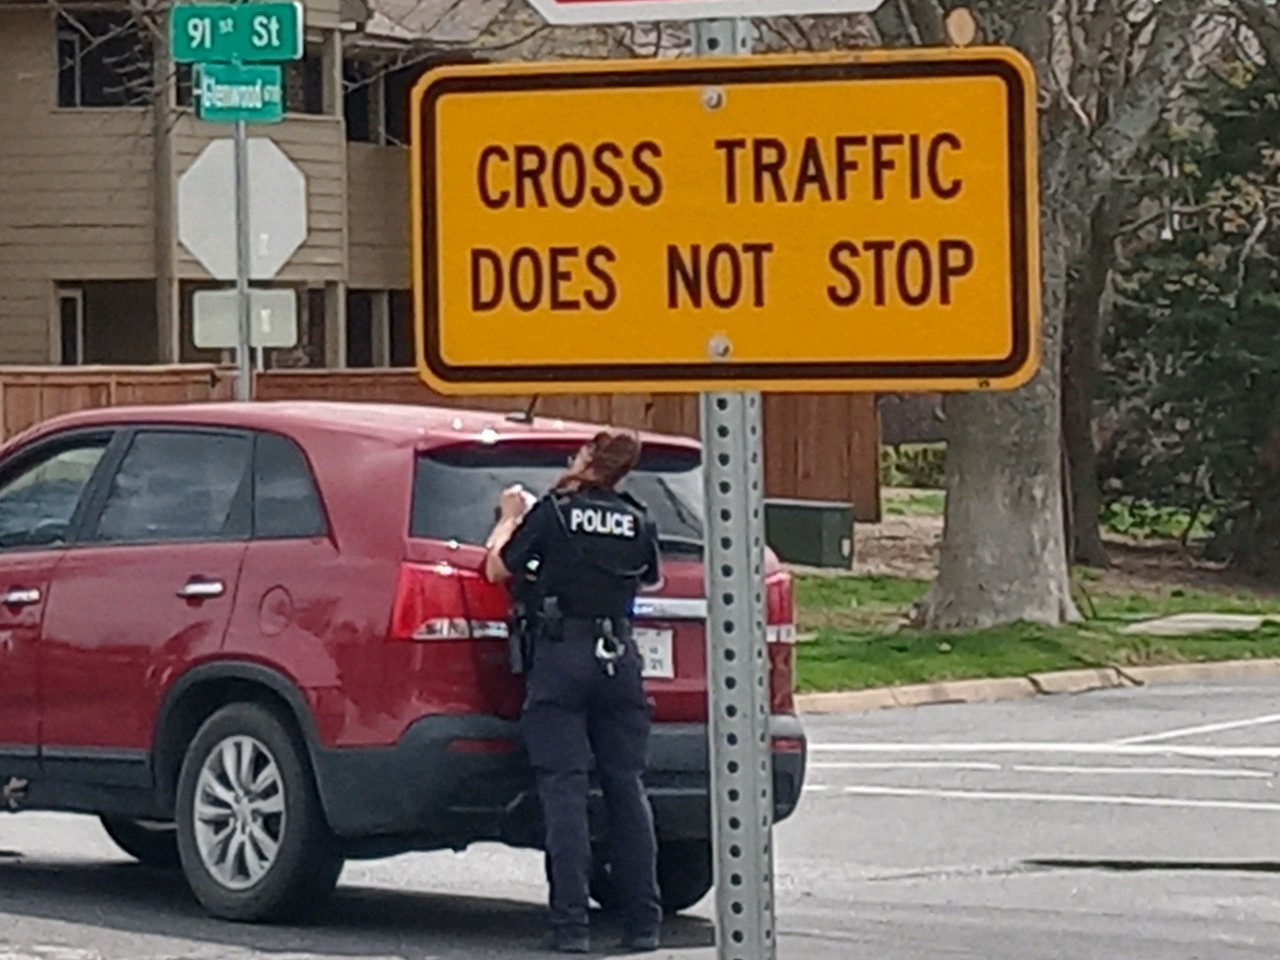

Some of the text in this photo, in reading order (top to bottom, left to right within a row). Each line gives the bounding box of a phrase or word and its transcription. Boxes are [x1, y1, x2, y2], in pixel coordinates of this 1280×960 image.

[251, 14, 281, 48] St
[476, 132, 963, 210] CROSS TRAFFIC
[469, 239, 974, 312] DOES NOT STOP
[570, 507, 636, 538] POLICE
